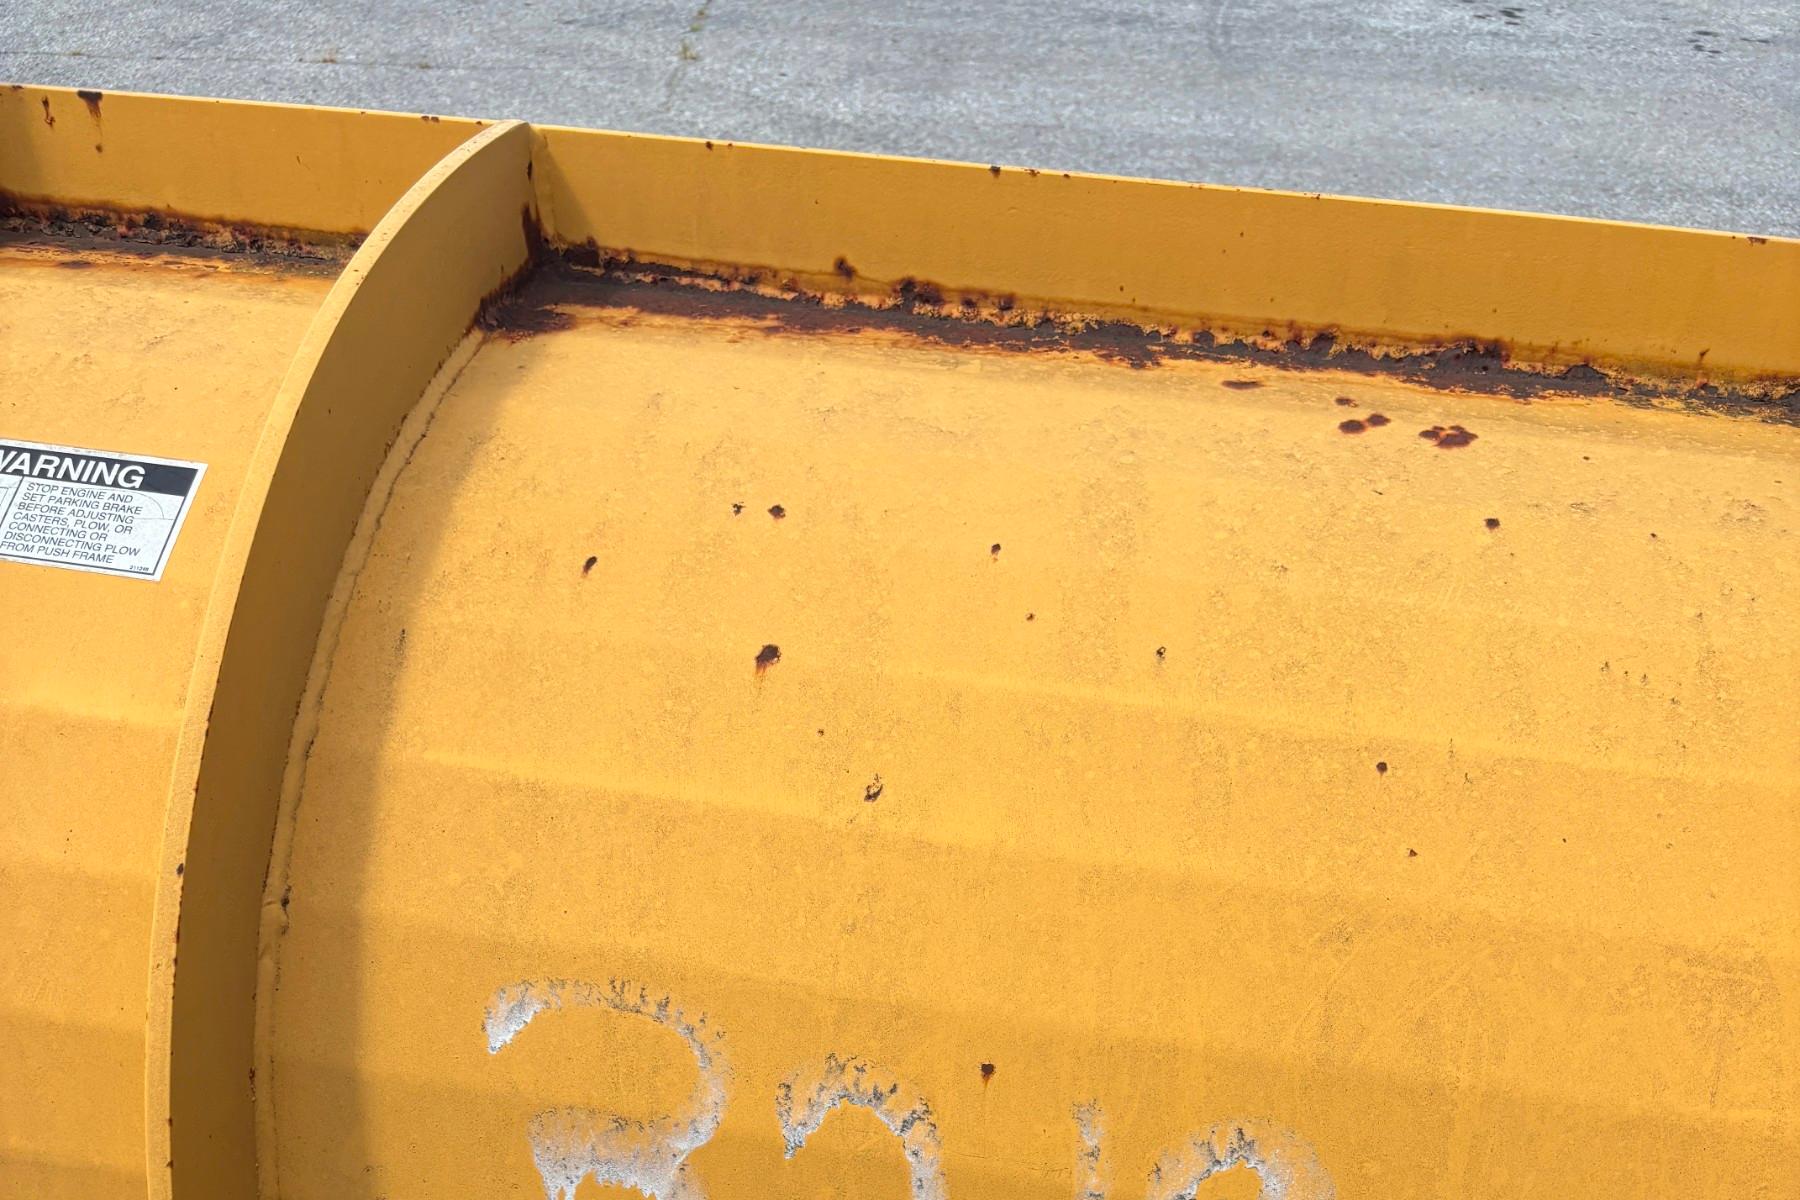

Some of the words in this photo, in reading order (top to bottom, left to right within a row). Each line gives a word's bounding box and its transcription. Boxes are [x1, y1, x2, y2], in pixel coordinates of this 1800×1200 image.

[22, 492, 46, 502] SET
[48, 495, 100, 510] PARKING
[102, 502, 143, 515] BRAKE
[26, 482, 60, 494] STOP
[61, 486, 107, 500] ENGINE
[109, 493, 134, 504] AND
[13, 511, 70, 528] CASTERS,
[73, 519, 110, 533] PLOW,
[114, 524, 133, 535] OR
[17, 501, 67, 515] BEFORE
[67, 508, 135, 525] ADJUSTING
[8, 521, 87, 539] CONNECTING
[89, 531, 108, 542] OR
[0, 541, 35, 553] FROM
[36, 545, 70, 557] PUSH
[71, 551, 115, 564] FRAME
[4, 531, 102, 552] DISCONNECTING
[105, 545, 141, 557] PLOW
